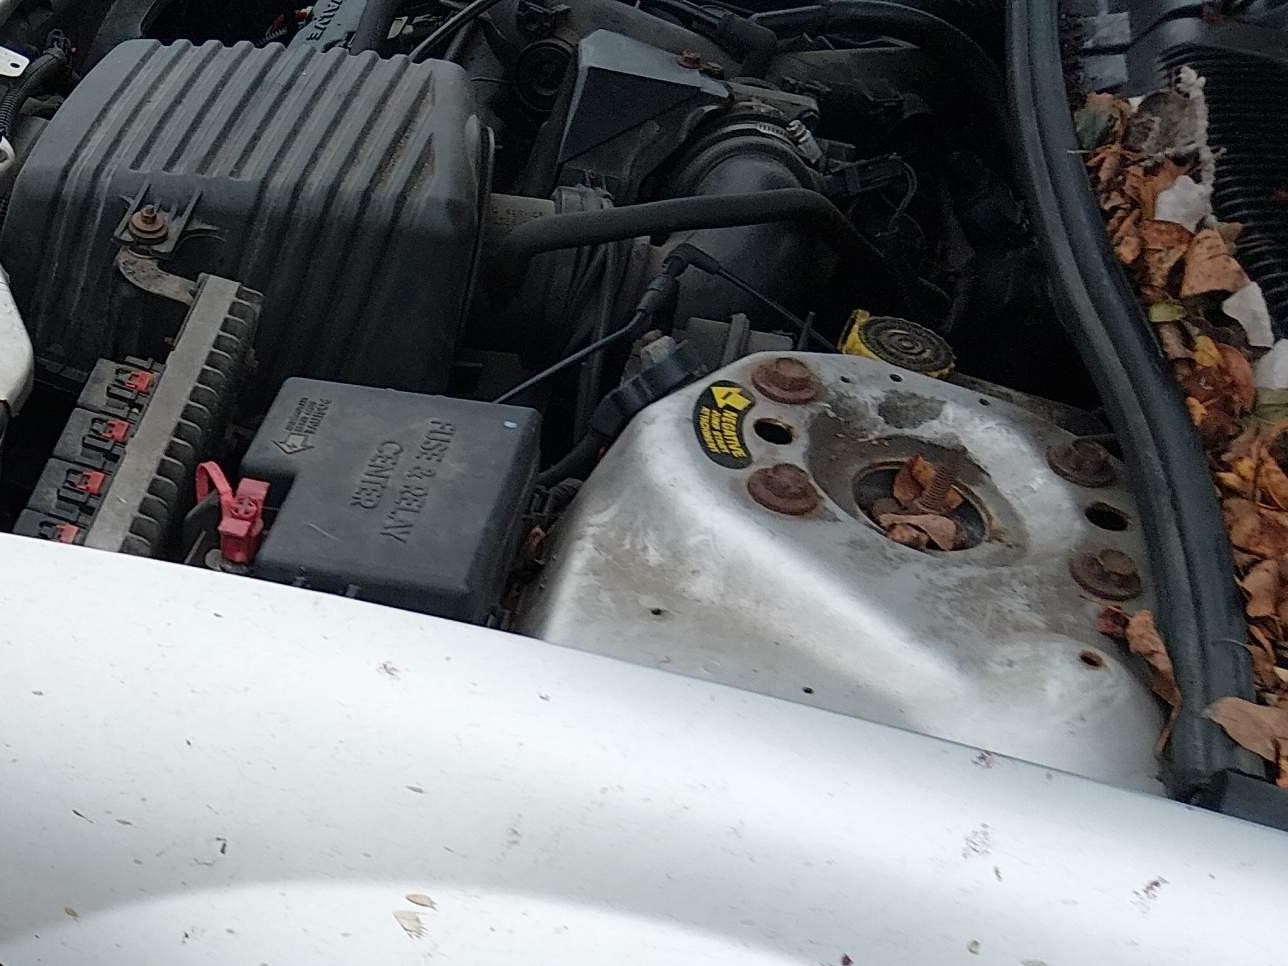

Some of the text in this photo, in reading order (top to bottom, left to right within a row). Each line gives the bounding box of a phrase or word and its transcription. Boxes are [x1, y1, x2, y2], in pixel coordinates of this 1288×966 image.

[721, 408, 747, 458] NEGATIVE
[350, 440, 404, 510] CENTER
[379, 419, 455, 544] FUSE & RELAY
